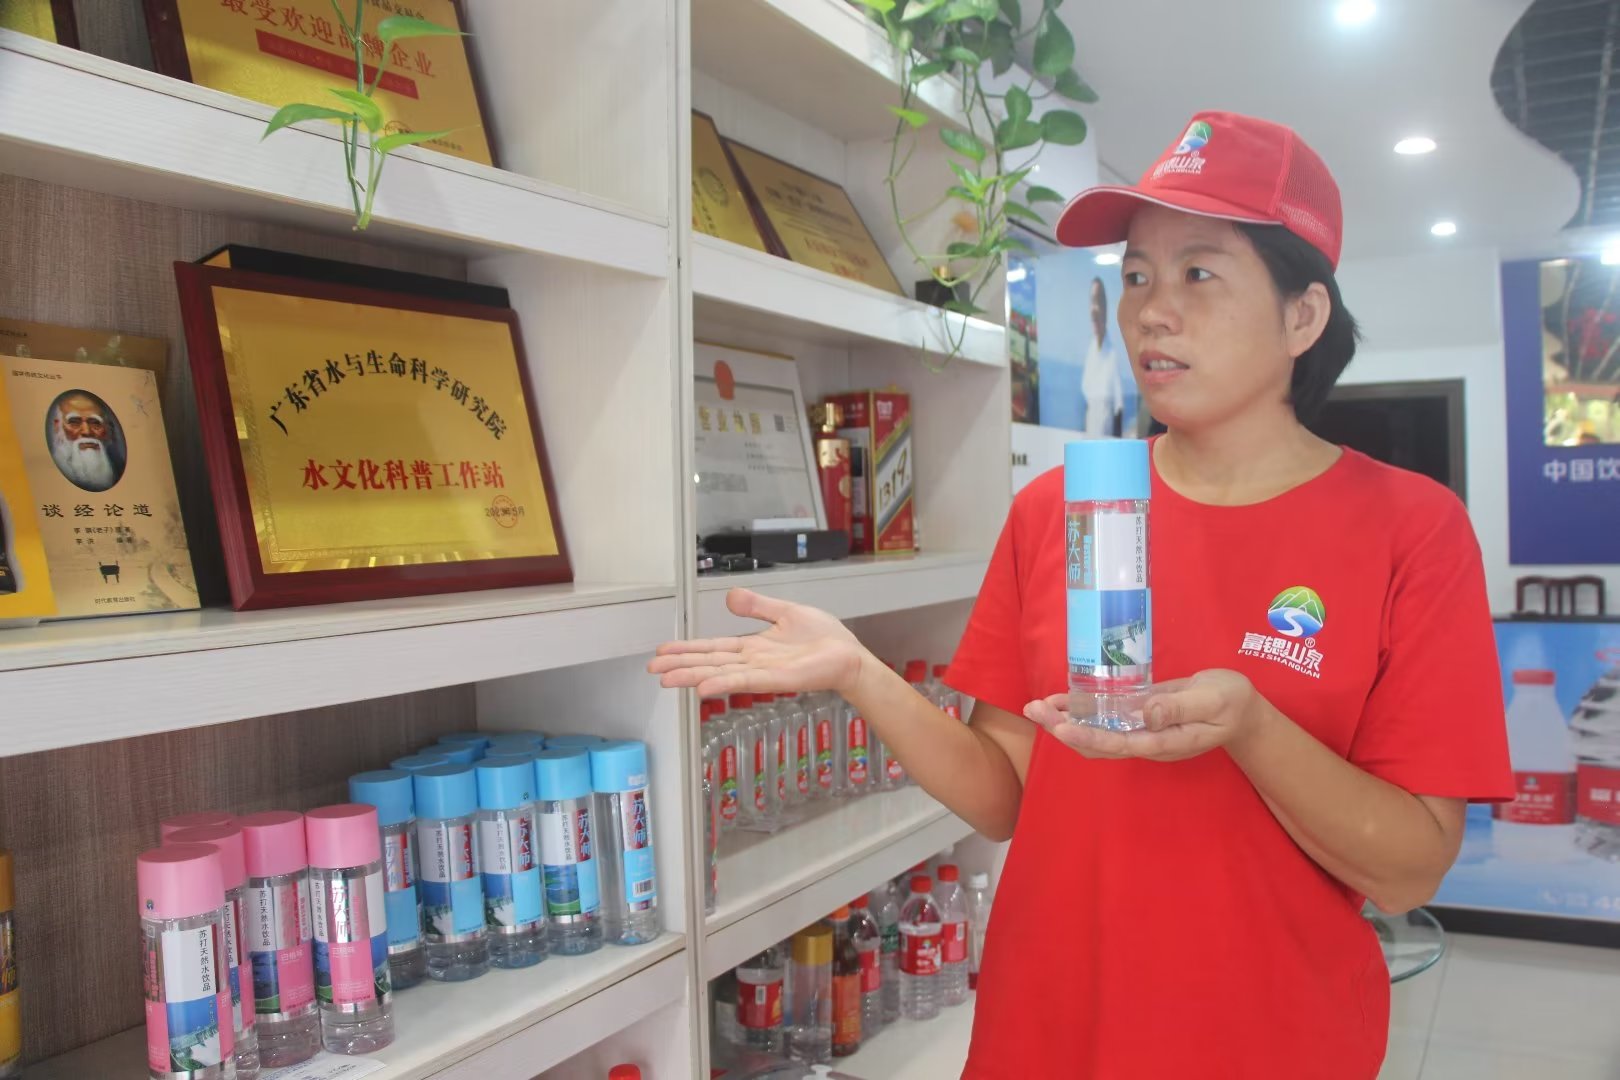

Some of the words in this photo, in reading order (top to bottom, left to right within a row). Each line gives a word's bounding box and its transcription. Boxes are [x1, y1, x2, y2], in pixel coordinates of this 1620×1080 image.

[268, 350, 508, 440] 广东省水与生命科学研究院
[301, 458, 505, 491] 水文化科普工作站
[41, 503, 153, 518] 谈经论道
[1068, 520, 1081, 584] 苏大师
[1135, 516, 1143, 583] 苏打天然水饮品
[1237, 648, 1321, 679] FUSISHANQUAN
[200, 929, 212, 992] 苏打天然水饮品
